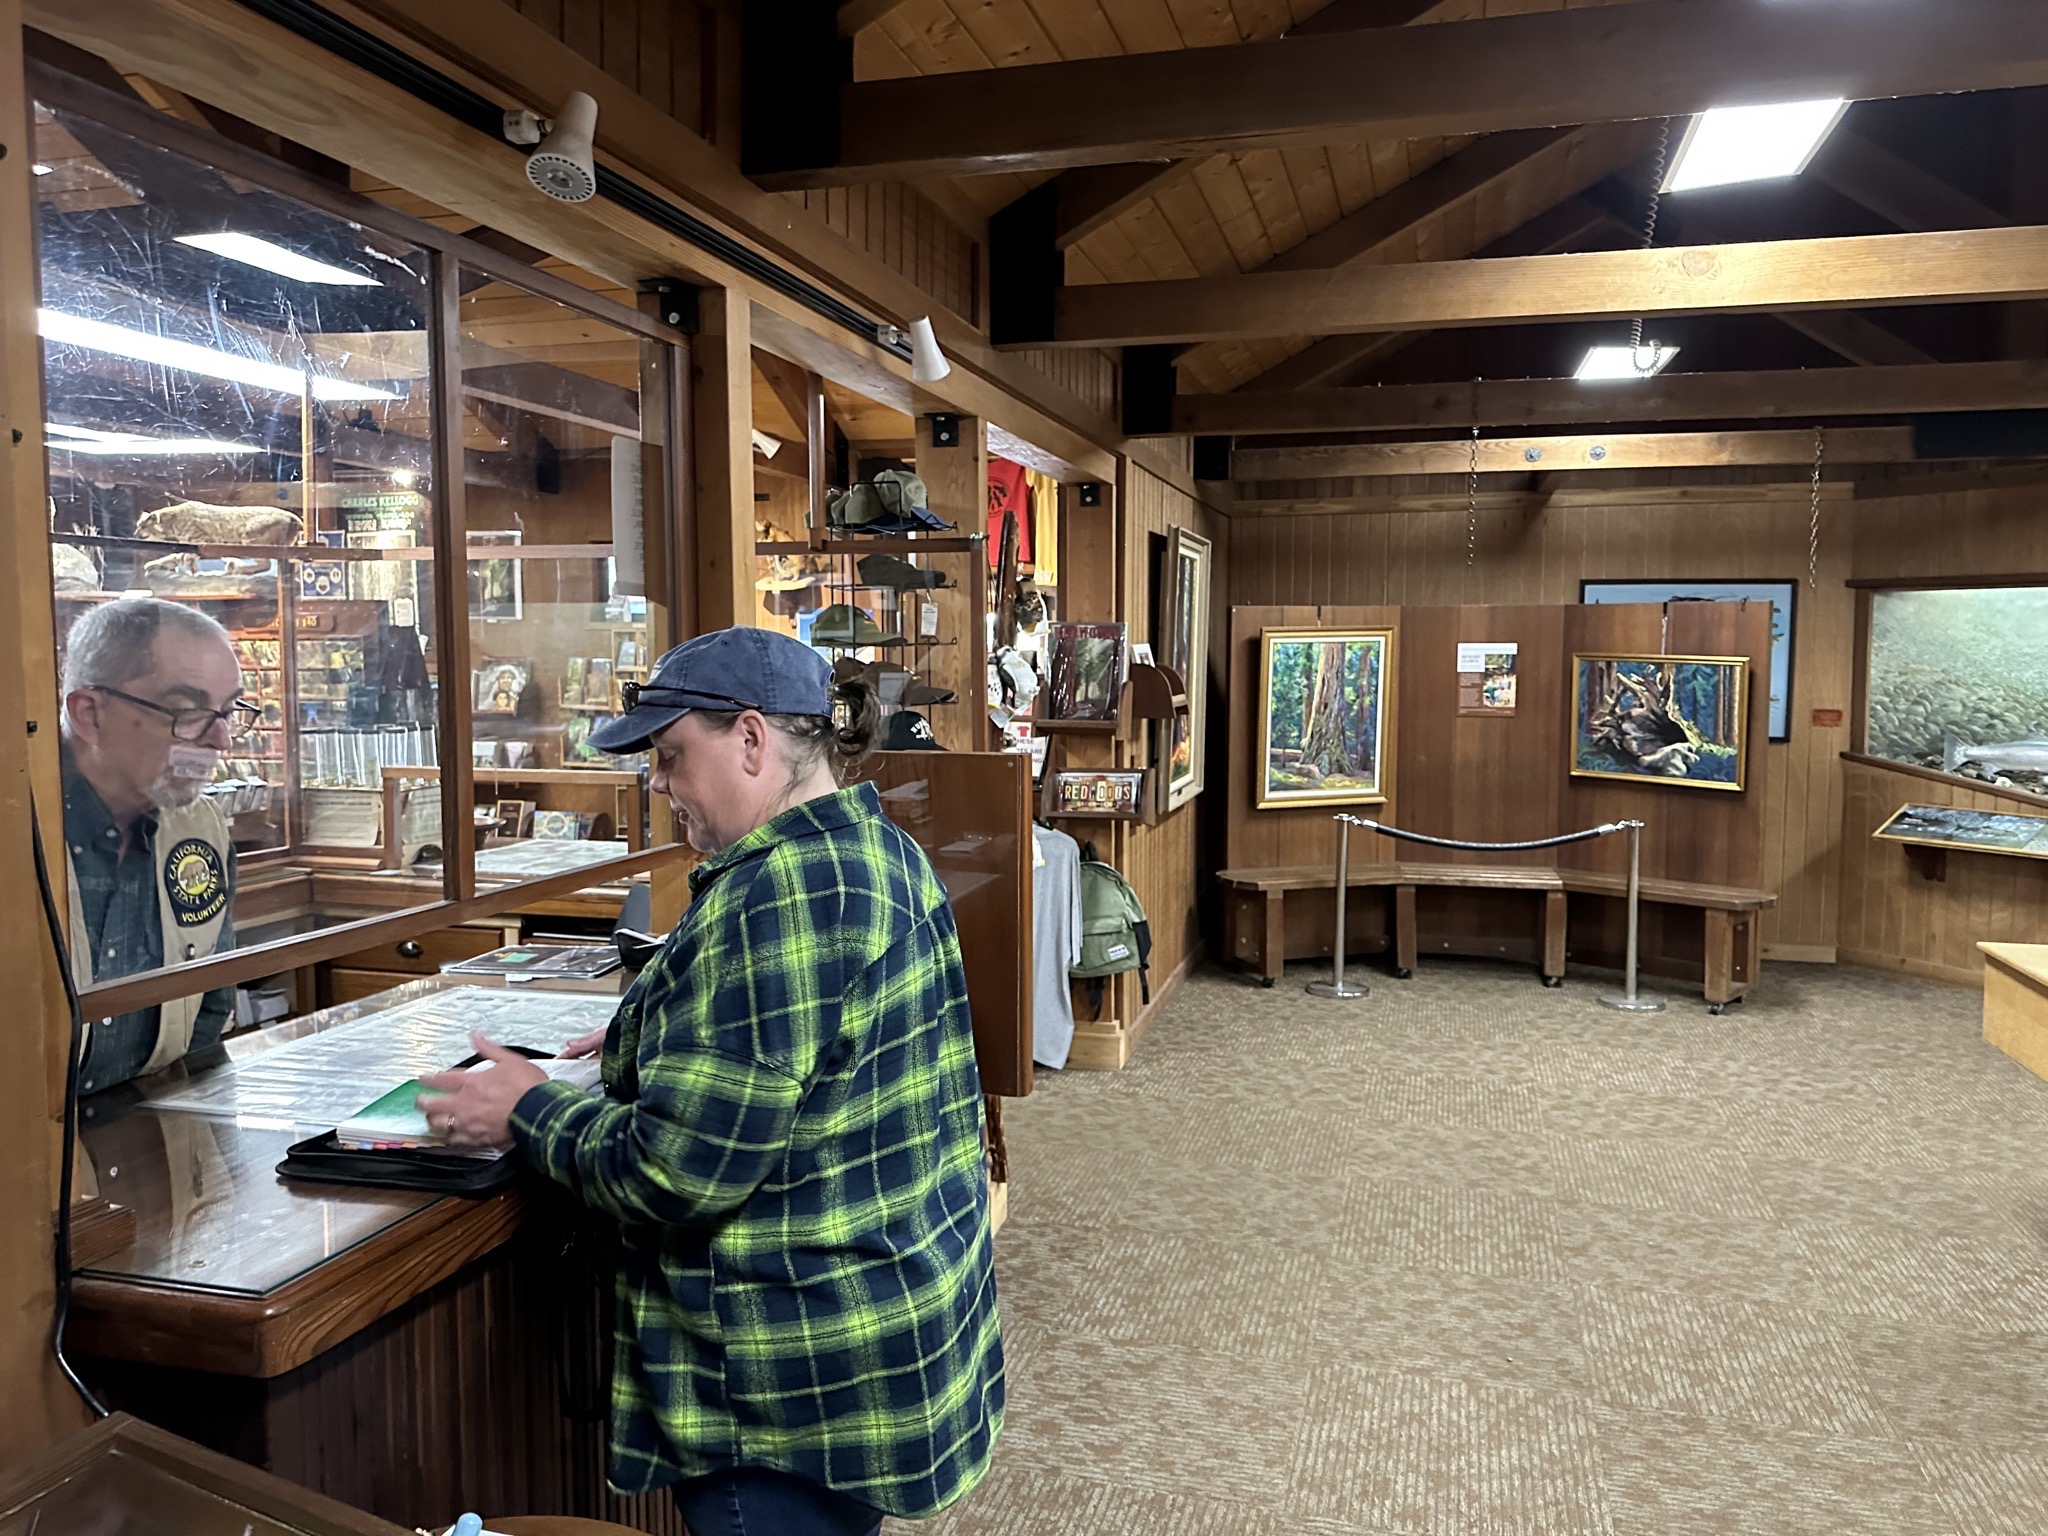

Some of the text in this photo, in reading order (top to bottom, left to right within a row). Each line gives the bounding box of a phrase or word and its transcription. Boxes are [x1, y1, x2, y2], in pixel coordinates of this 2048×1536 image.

[341, 495, 419, 508] CHARLES KELLOGG
[169, 844, 213, 880] CALIFORNIA
[173, 869, 218, 905] STATE PARKS
[182, 892, 226, 922] VOLUNTEER
